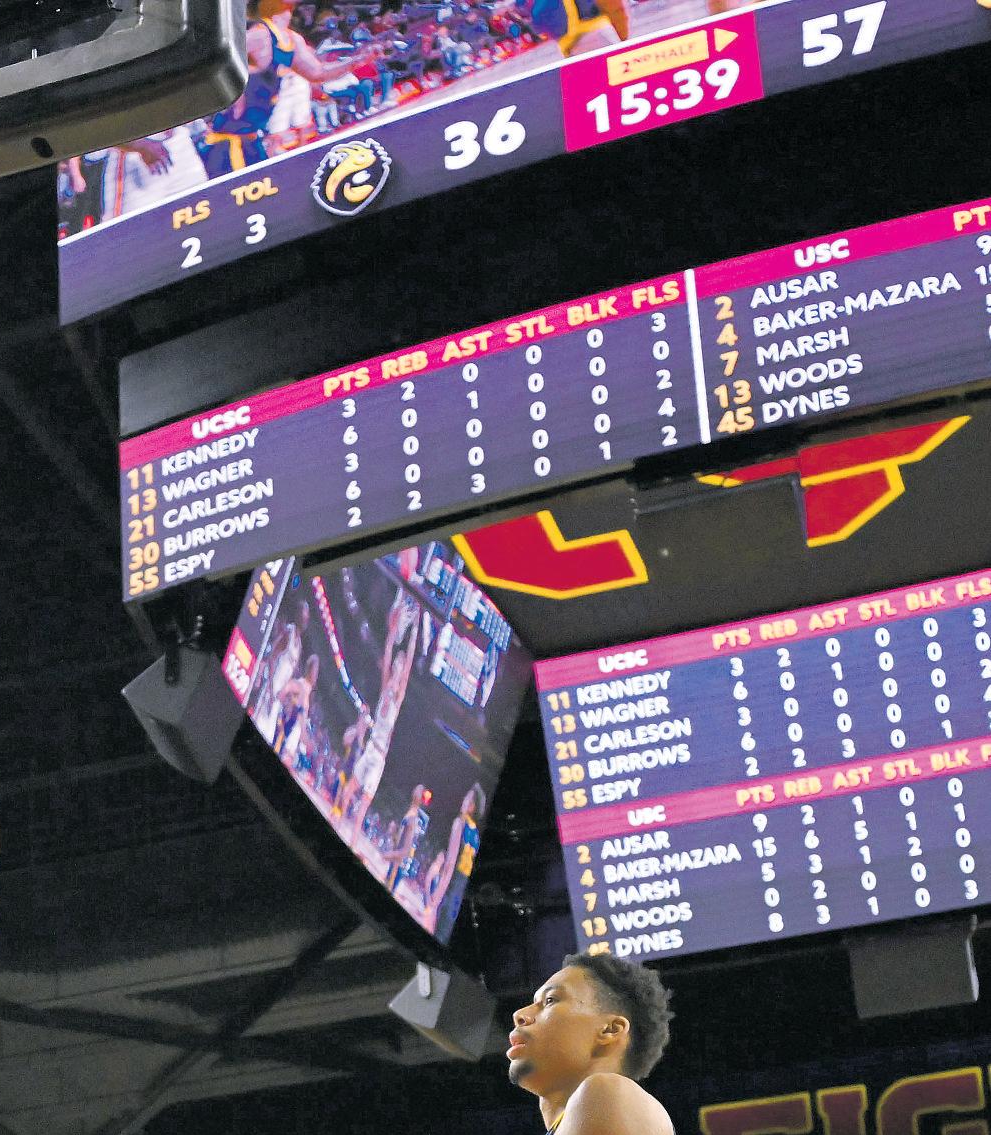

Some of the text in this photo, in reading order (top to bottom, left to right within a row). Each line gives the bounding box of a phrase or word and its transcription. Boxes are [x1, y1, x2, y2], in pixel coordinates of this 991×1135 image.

[655, 42, 698, 64] HALF
[801, 1, 887, 68] 57
[586, 59, 740, 133] 15:39
[444, 105, 527, 170] 36
[172, 177, 279, 230] FLS TOL
[181, 213, 267, 269] 2 3
[794, 238, 850, 268] USC
[714, 296, 734, 321] 2
[750, 271, 839, 309] AUSAR
[716, 323, 738, 347] 4
[753, 272, 961, 337] BAKER-MAZARA
[191, 279, 680, 439] UCSC PTS REB AST STL BLK FLS
[714, 353, 863, 409] 13 WOODS
[719, 326, 850, 377] 7 MARSH
[127, 312, 667, 490] 11 KENNEDY 3 2 0 0 0 3
[128, 340, 670, 515] 13 WAGNER 6 0 1 0 0 0
[716, 385, 850, 434] 45 DYNES
[128, 368, 673, 543] 21 CARLESON 3 0 0 0 0 2
[128, 397, 677, 570] 30 BURROWS 6 0 0 0 0 4
[128, 425, 678, 596] 55 ESPY 2 2 3 0 1 2
[548, 607, 987, 710] 11 KENNEDY 3 2 0 0 0 3
[598, 649, 649, 673] UCSC
[712, 629, 751, 652] PTS
[759, 620, 798, 642] REB
[809, 608, 848, 631] AST
[858, 600, 897, 622] STL
[905, 587, 946, 611] BLK
[550, 631, 991, 735] 13 WAGNER 6 0 1 0 0 0
[555, 717, 692, 759] 21 CARLESON
[558, 743, 691, 785] 30 BURROWS
[562, 777, 642, 809] 55 ESPY
[736, 786, 775, 807] PTS
[784, 776, 822, 798] REB
[833, 765, 872, 789] AST
[882, 757, 921, 779] STL
[930, 748, 970, 772] BLK
[577, 777, 964, 864] 2 AUSAR 9 2 1 0 0
[580, 802, 966, 888] 4 BAKER-MAZARA 15 6 5 1 1
[581, 901, 693, 938] 13 WOODS
[583, 878, 681, 912] 7 MARSH
[615, 929, 684, 957] DYNES
